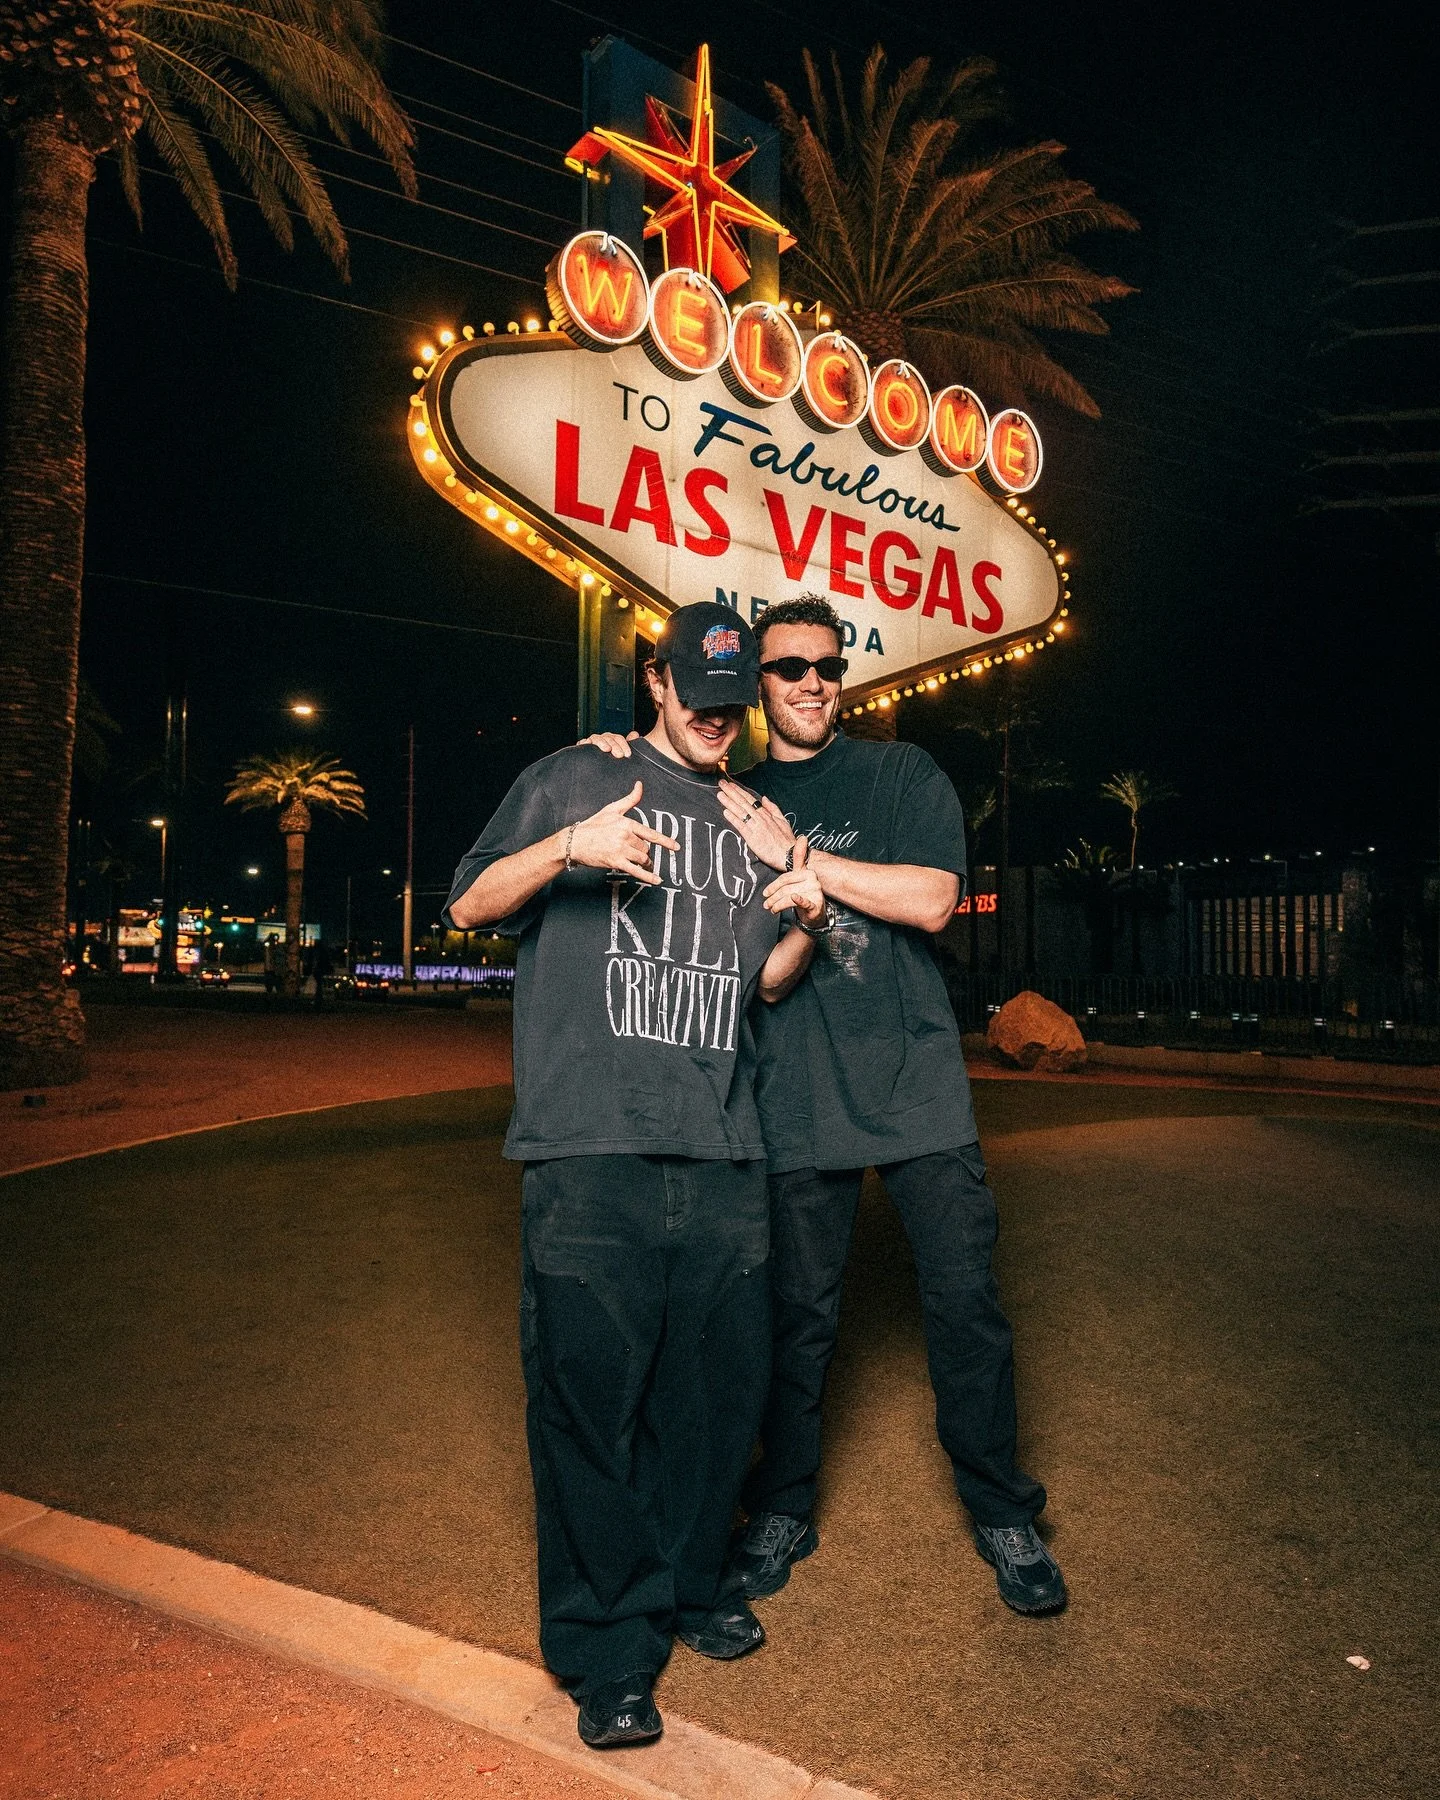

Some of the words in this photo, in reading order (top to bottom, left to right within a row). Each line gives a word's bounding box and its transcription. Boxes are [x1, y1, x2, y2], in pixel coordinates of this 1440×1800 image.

[575, 253, 1028, 478] WELCOME
[553, 418, 731, 557] LAS
[763, 487, 1005, 634] VEGAS
[612, 381, 671, 431] TO
[693, 402, 961, 532] Fabulous
[715, 586, 885, 656] NEDA
[617, 1714, 632, 1729] 45
